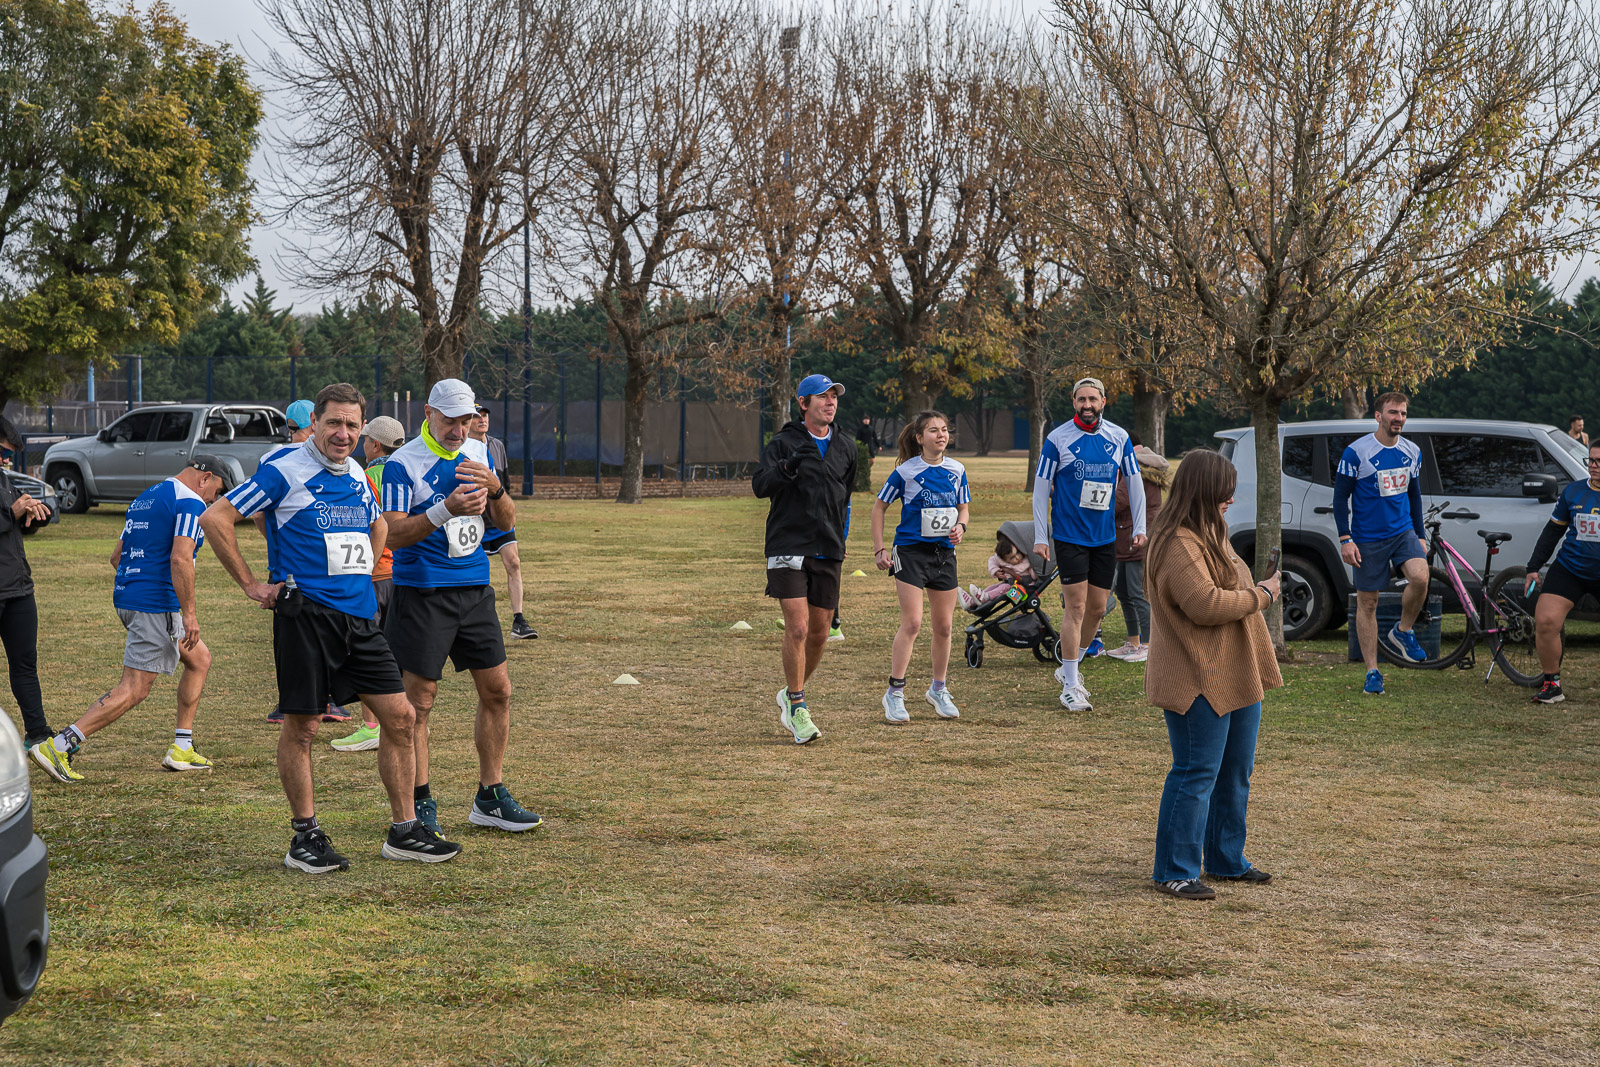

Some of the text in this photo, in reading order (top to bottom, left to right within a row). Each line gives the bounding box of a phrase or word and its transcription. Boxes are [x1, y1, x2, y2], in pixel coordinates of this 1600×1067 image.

[1074, 459, 1085, 480] 3
[1383, 474, 1407, 489] 512
[921, 489, 933, 507] 3
[1090, 490, 1107, 503] 17
[314, 501, 331, 529] 3
[931, 516, 950, 530] 62
[458, 524, 478, 546] 68
[1580, 520, 1600, 534] 51
[340, 543, 367, 565] 72
